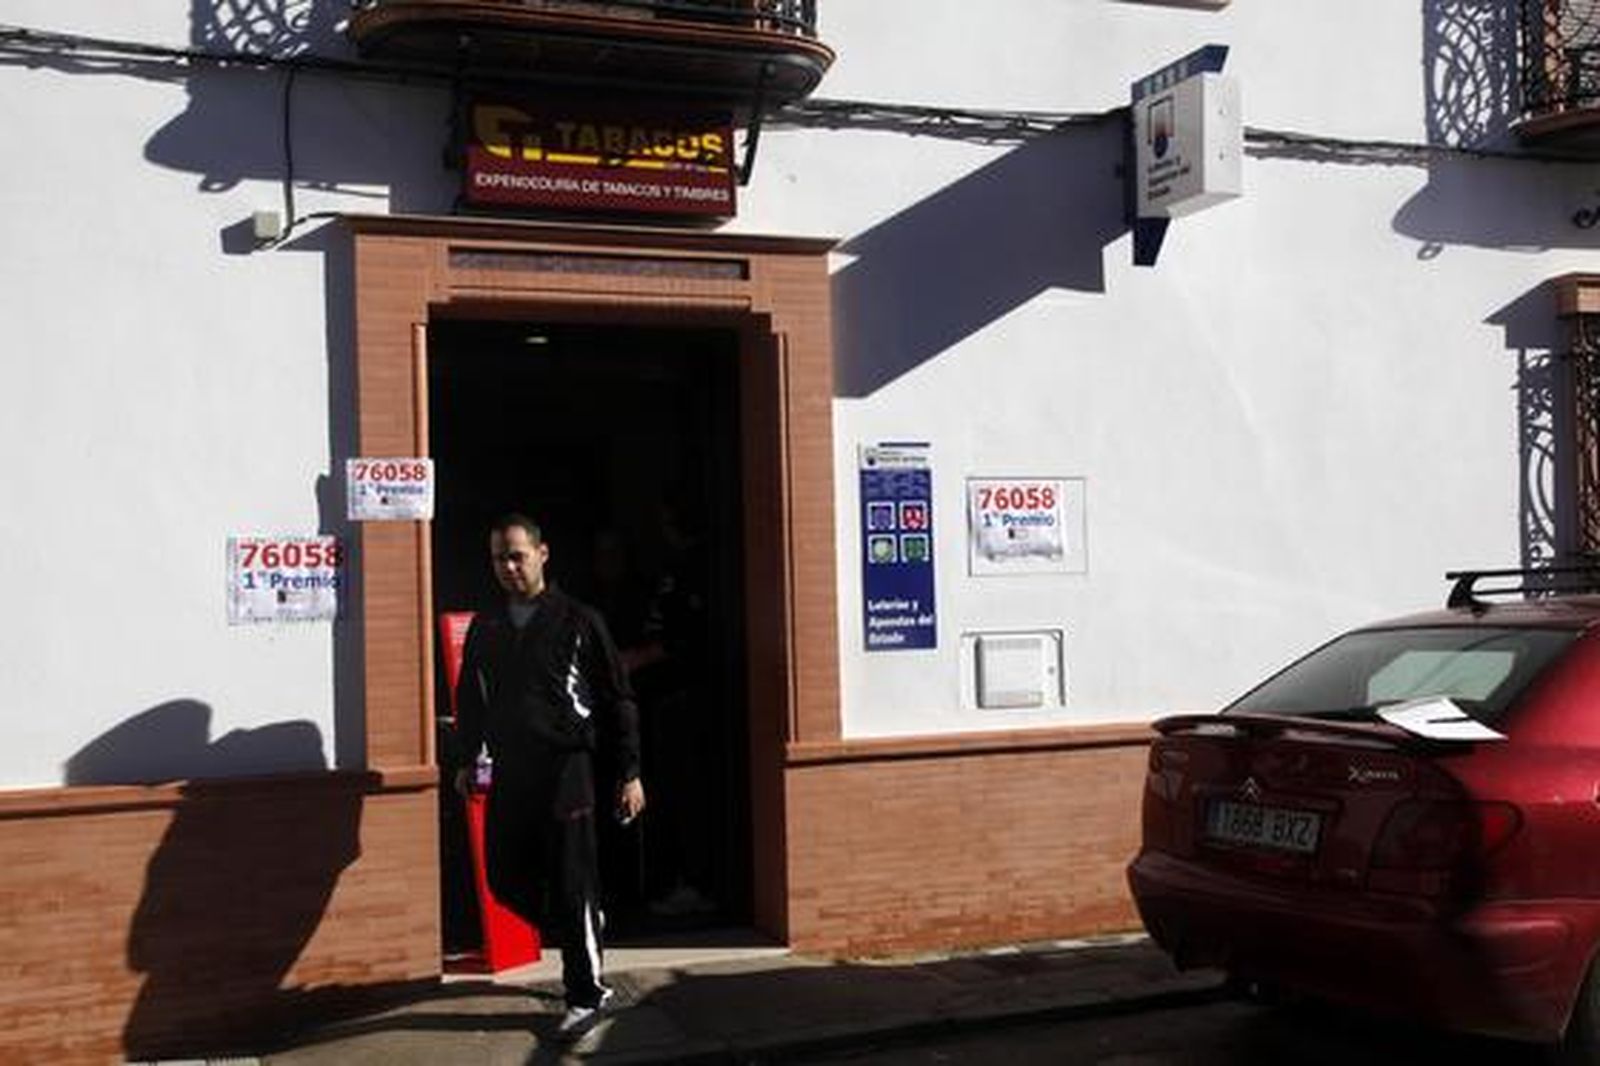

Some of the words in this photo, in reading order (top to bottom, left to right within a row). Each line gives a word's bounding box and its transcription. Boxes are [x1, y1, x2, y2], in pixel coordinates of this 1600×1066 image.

[555, 121, 724, 160] TABACOS
[356, 463, 427, 481] 76058
[979, 486, 1056, 510] 76058
[1002, 511, 1055, 527] Premio
[239, 542, 343, 569] 76058
[270, 570, 341, 590] Premio
